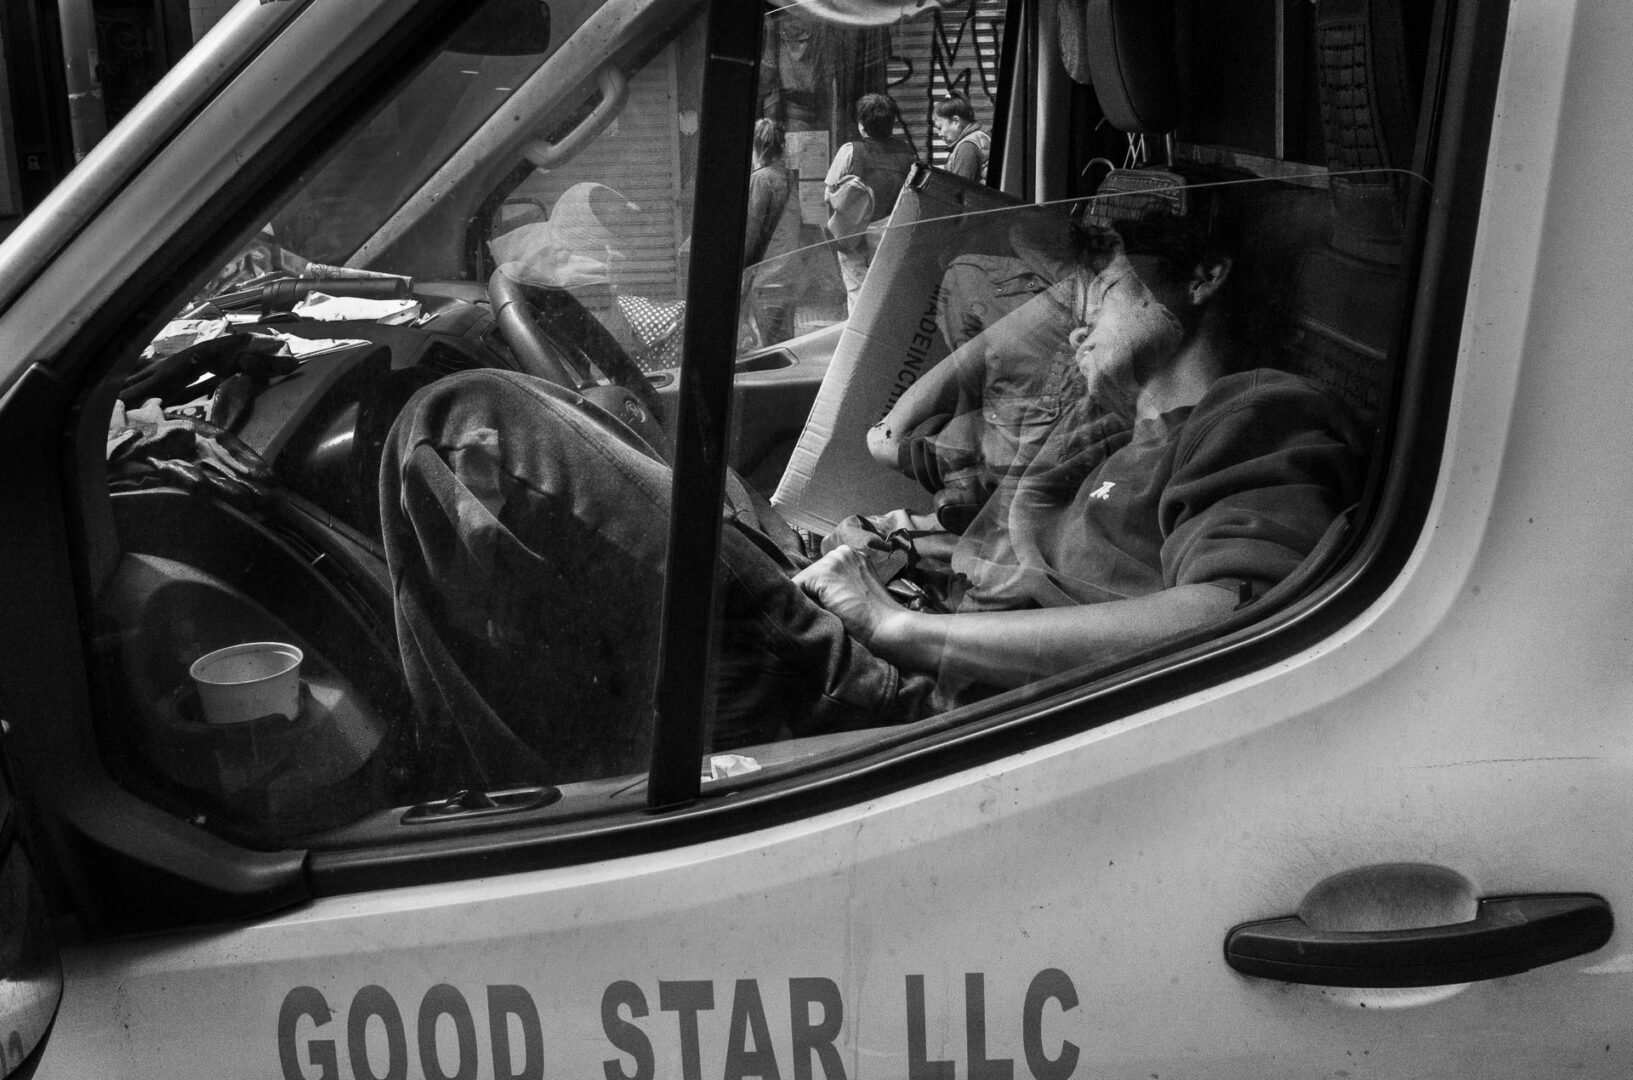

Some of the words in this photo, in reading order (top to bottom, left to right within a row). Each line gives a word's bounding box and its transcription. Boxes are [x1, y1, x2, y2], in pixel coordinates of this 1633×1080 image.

[277, 983, 545, 1080] GOOD
[601, 977, 848, 1080] STAR
[905, 968, 1080, 1080] LLC
